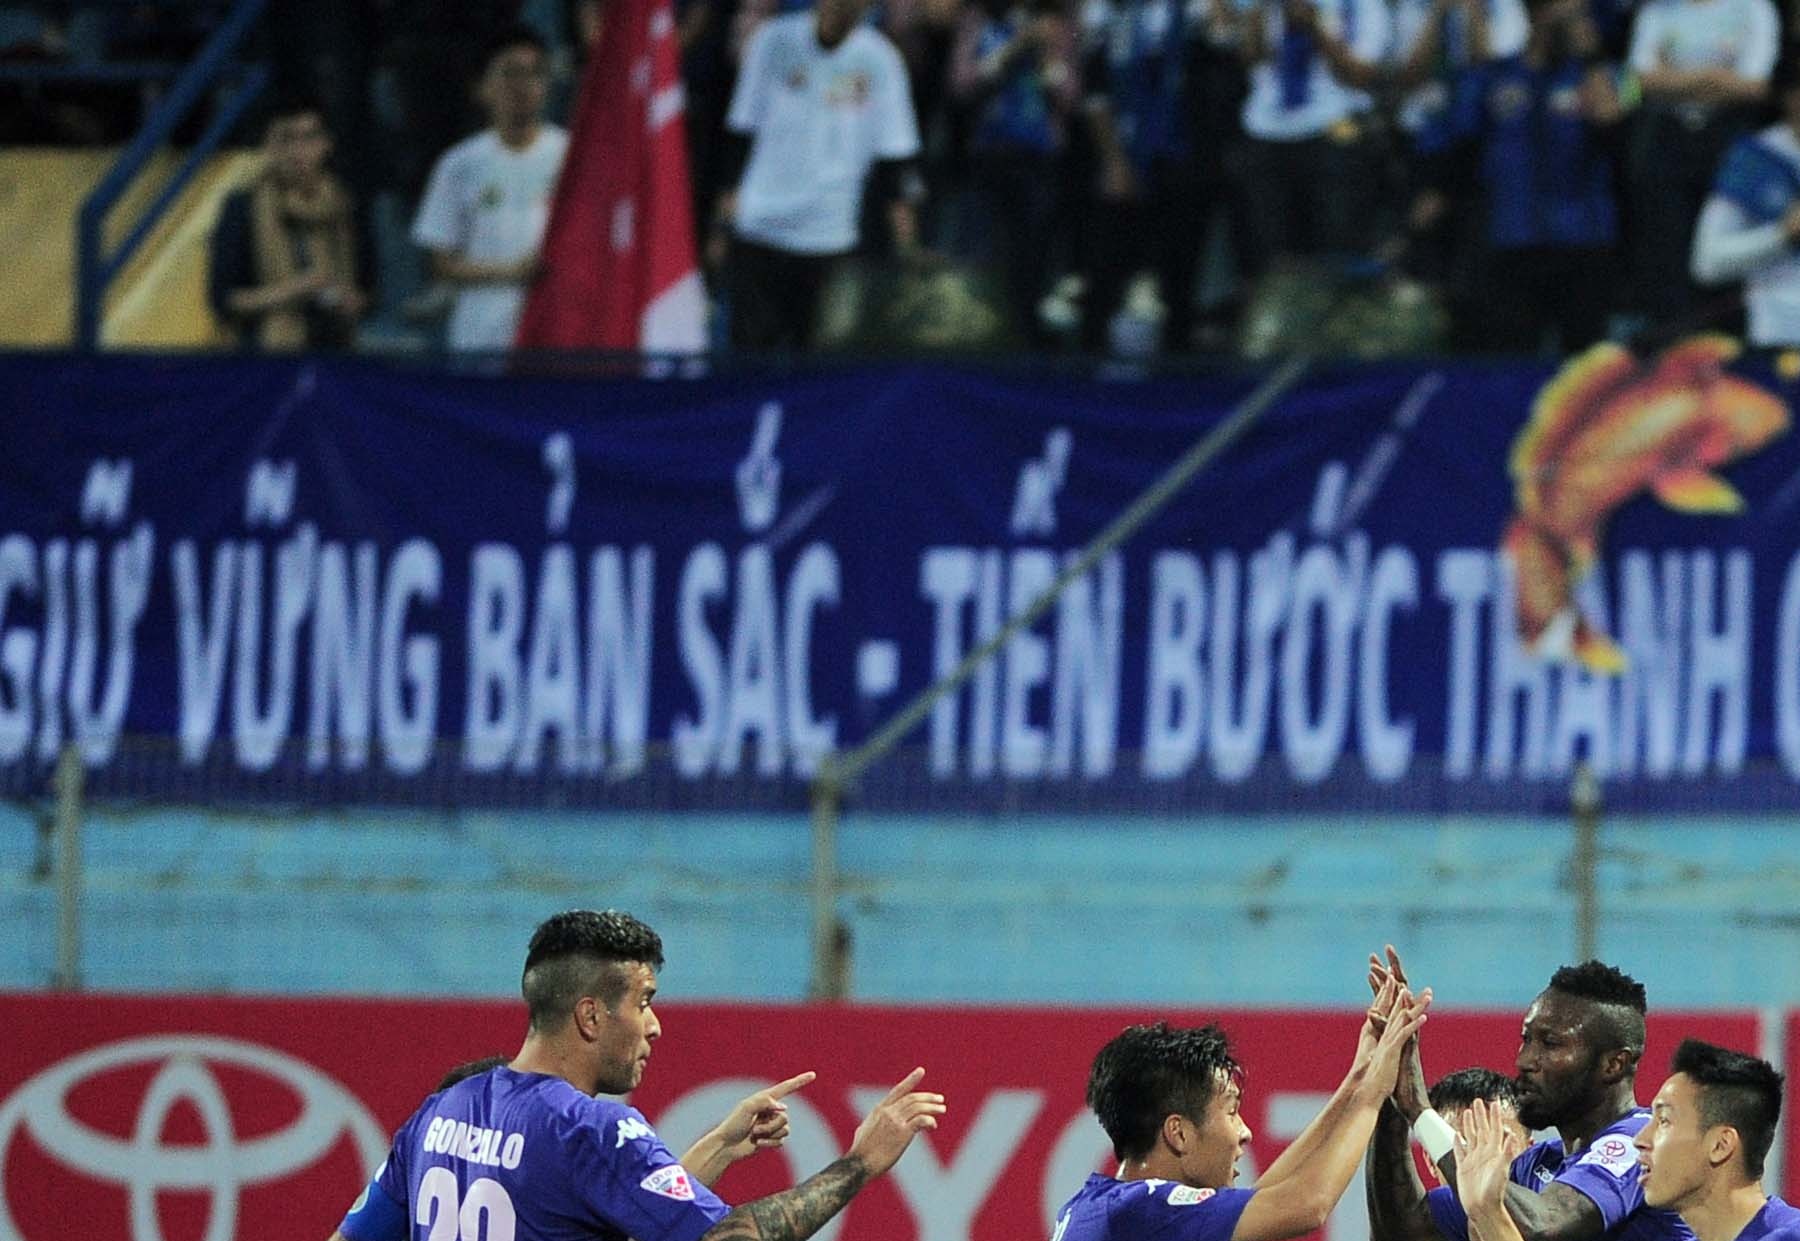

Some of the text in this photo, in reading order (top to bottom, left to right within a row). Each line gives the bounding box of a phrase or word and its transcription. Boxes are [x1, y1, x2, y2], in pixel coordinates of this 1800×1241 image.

[172, 459, 443, 775] VỮNG
[464, 430, 655, 777] BẢN
[918, 428, 1125, 780] TIẾN
[1141, 460, 1421, 783] BƯỚC
[423, 1116, 525, 1170] GONZALO
